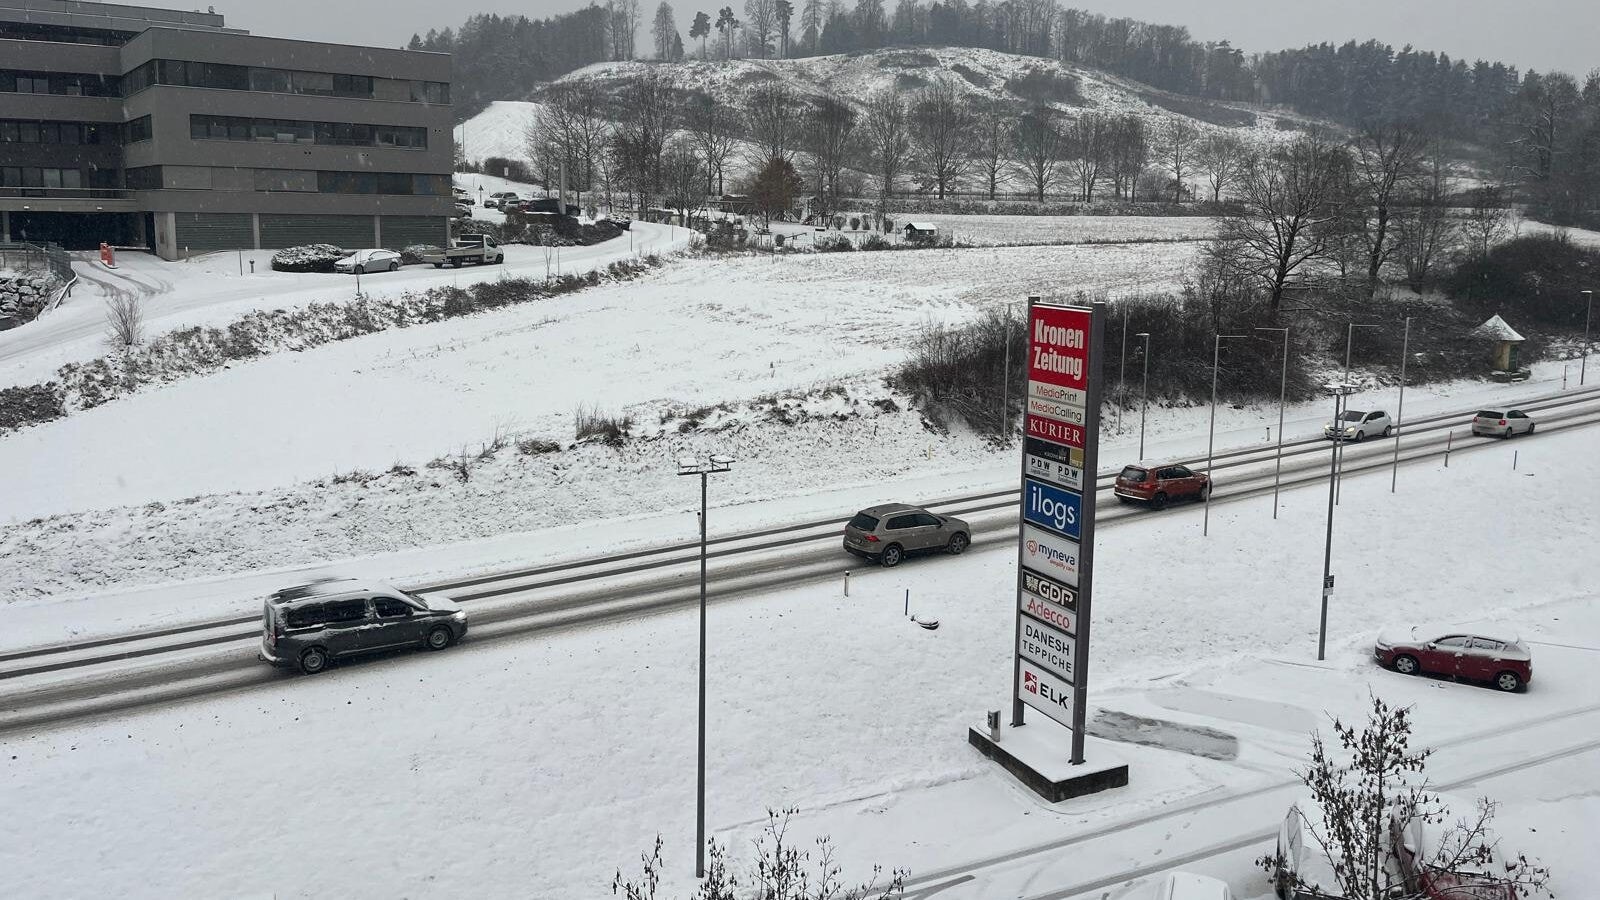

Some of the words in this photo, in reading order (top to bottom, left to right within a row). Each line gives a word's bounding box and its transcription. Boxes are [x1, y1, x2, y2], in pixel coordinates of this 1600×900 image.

[1034, 318, 1084, 349] Kronen
[1033, 346, 1083, 380] Zeitung
[1036, 385, 1077, 402] MediaPrint
[1031, 401, 1082, 423] MediaCalling
[1030, 418, 1081, 443] KURIER
[1031, 458, 1050, 470] PDW
[1058, 466, 1078, 479] PDW
[1032, 486, 1075, 529] ilogs
[1038, 544, 1075, 566] myneva
[1038, 580, 1074, 606] GDP
[1027, 598, 1070, 629] Adecco
[1025, 624, 1070, 656] DANESH
[1022, 639, 1072, 673] TEPPICHE
[1040, 682, 1069, 710] ELK
